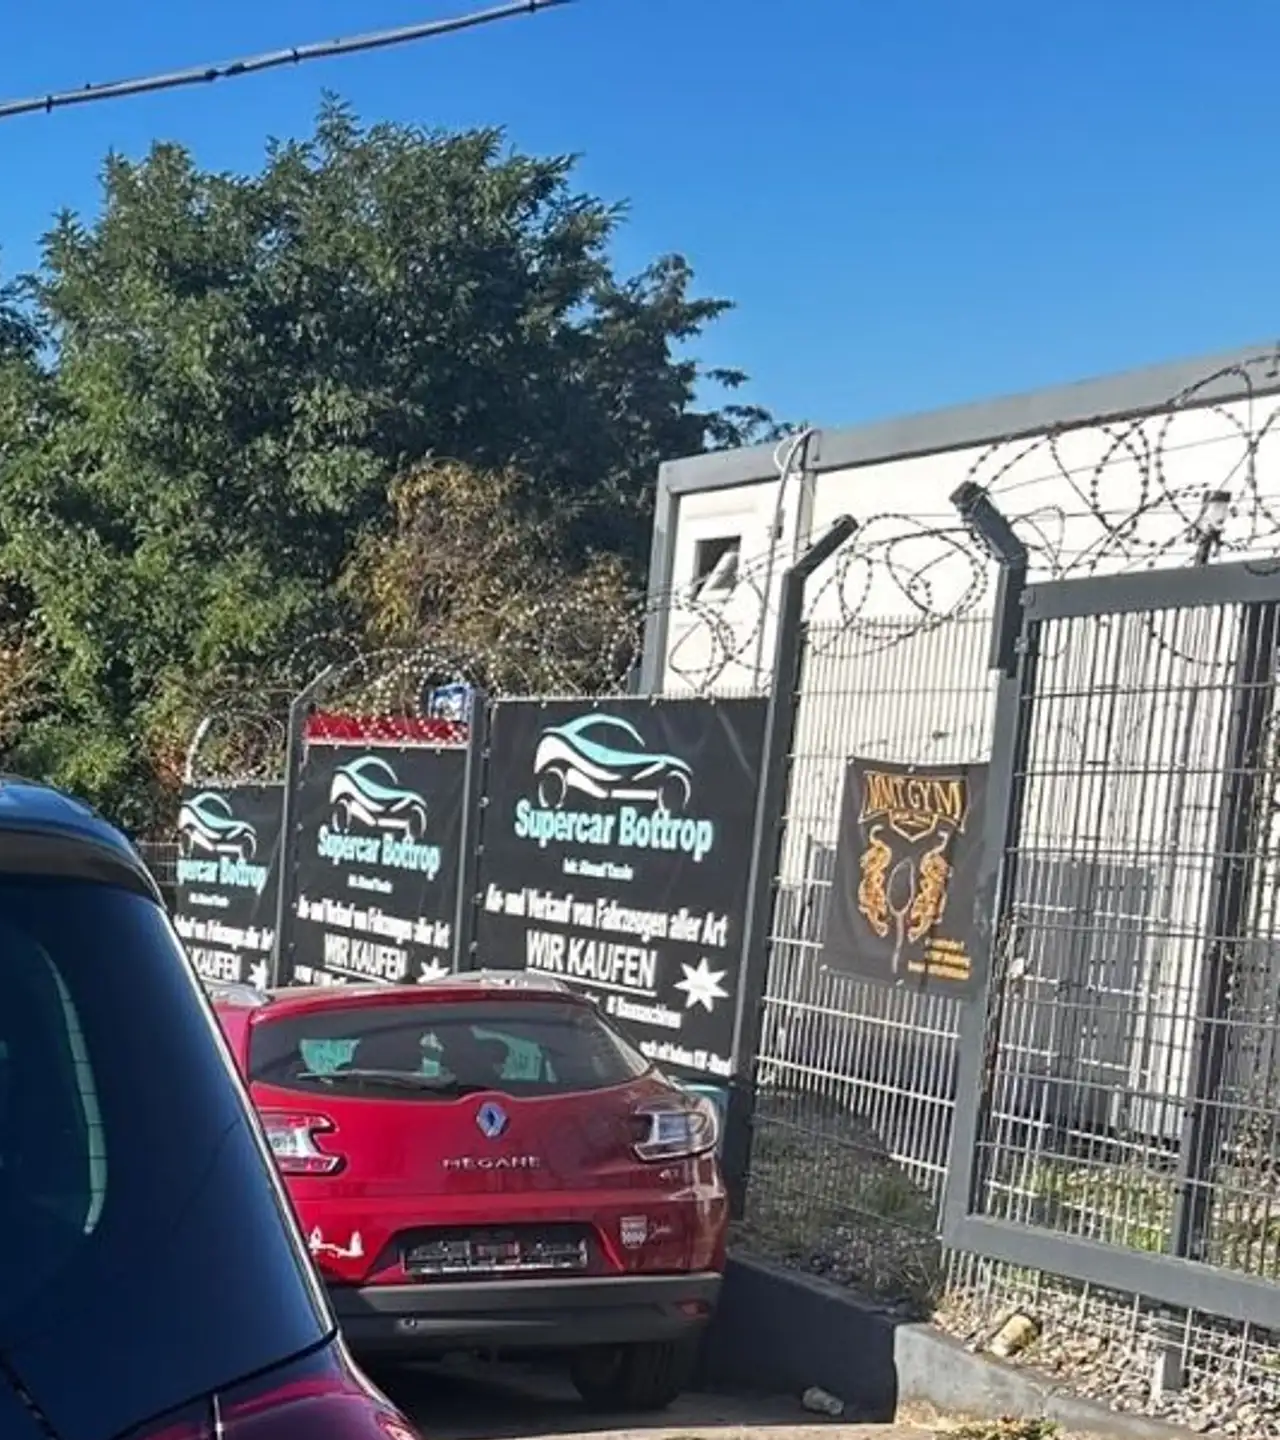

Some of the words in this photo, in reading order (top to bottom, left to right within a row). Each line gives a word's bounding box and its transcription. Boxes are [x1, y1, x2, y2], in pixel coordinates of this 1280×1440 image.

[908, 779, 962, 820] GYM
[317, 824, 381, 866] Supercar
[382, 831, 441, 882] Bottrop
[514, 798, 615, 849] Supercar
[618, 805, 714, 863] Bottrop
[669, 907, 703, 943] aller
[702, 911, 728, 948] Art
[191, 946, 242, 981] KAUFEN
[324, 932, 349, 968] WIR
[351, 938, 408, 981] KAUFEN
[525, 928, 565, 971] WIR
[566, 936, 659, 988] KAUFEN
[442, 1155, 541, 1168] MEGANE
